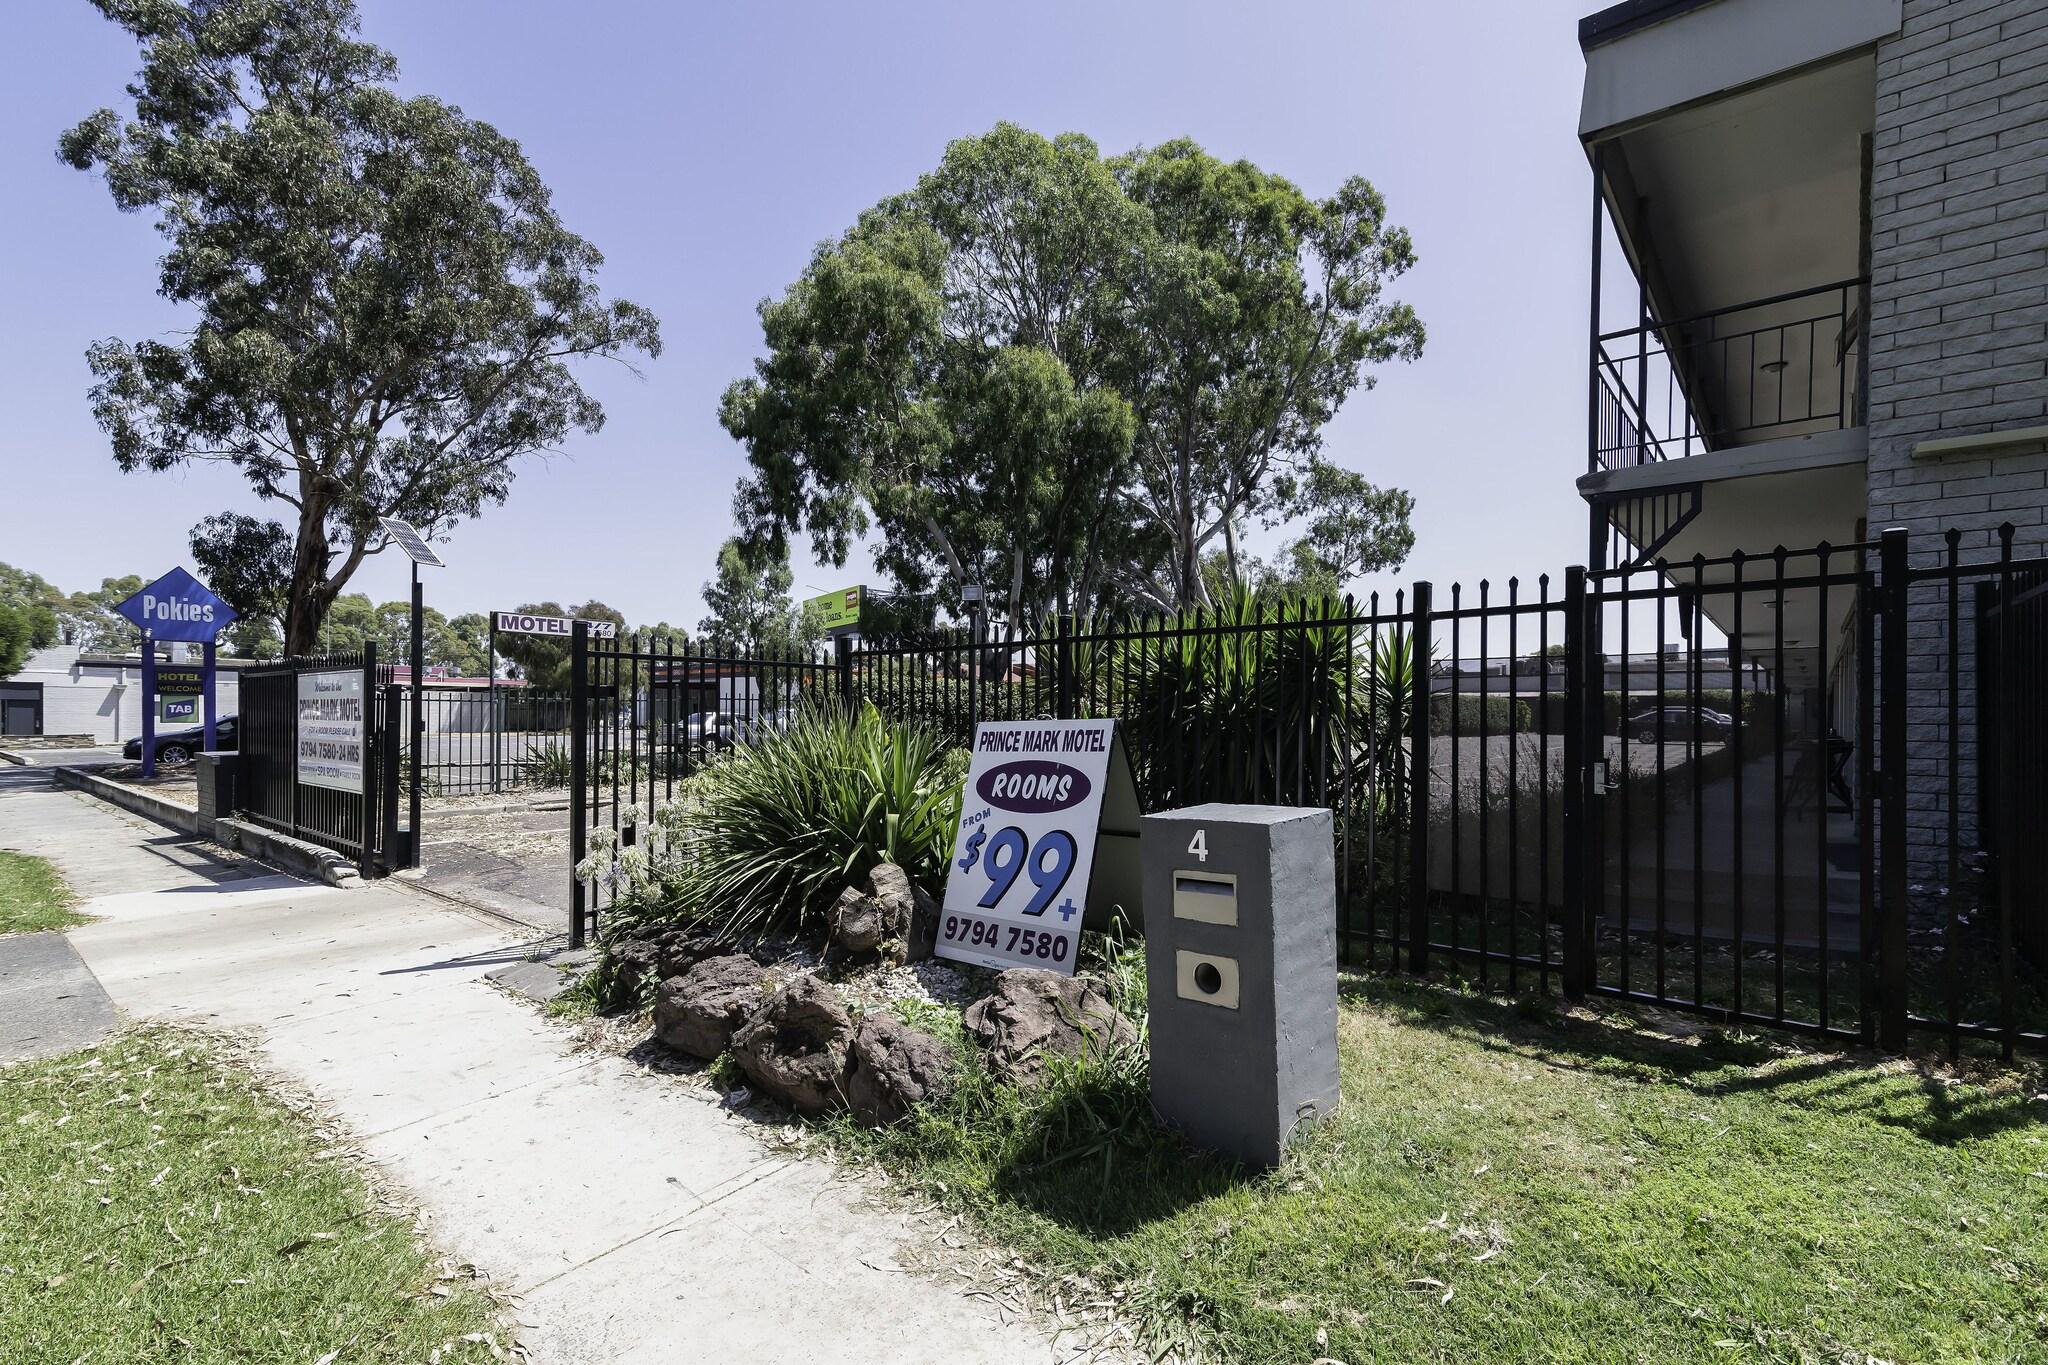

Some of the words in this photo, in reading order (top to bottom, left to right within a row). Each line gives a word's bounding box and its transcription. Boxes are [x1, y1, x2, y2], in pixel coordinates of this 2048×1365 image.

[143, 595, 214, 623] Pokies
[501, 615, 568, 633] MOTEL
[158, 673, 201, 681] HOTEL
[168, 704, 193, 713] TAB
[340, 698, 361, 721] MOTEL
[301, 741, 317, 758] 9794
[347, 744, 360, 762] HRS
[979, 731, 1021, 752] PRINCE
[1022, 730, 1061, 752] MARK
[1062, 729, 1106, 752] MOTEL
[991, 772, 1073, 802] ROOMS
[962, 808, 992, 829] FROM
[1187, 829, 1209, 862] 4
[944, 915, 1000, 949] 9794
[1005, 926, 1069, 962] 7580
